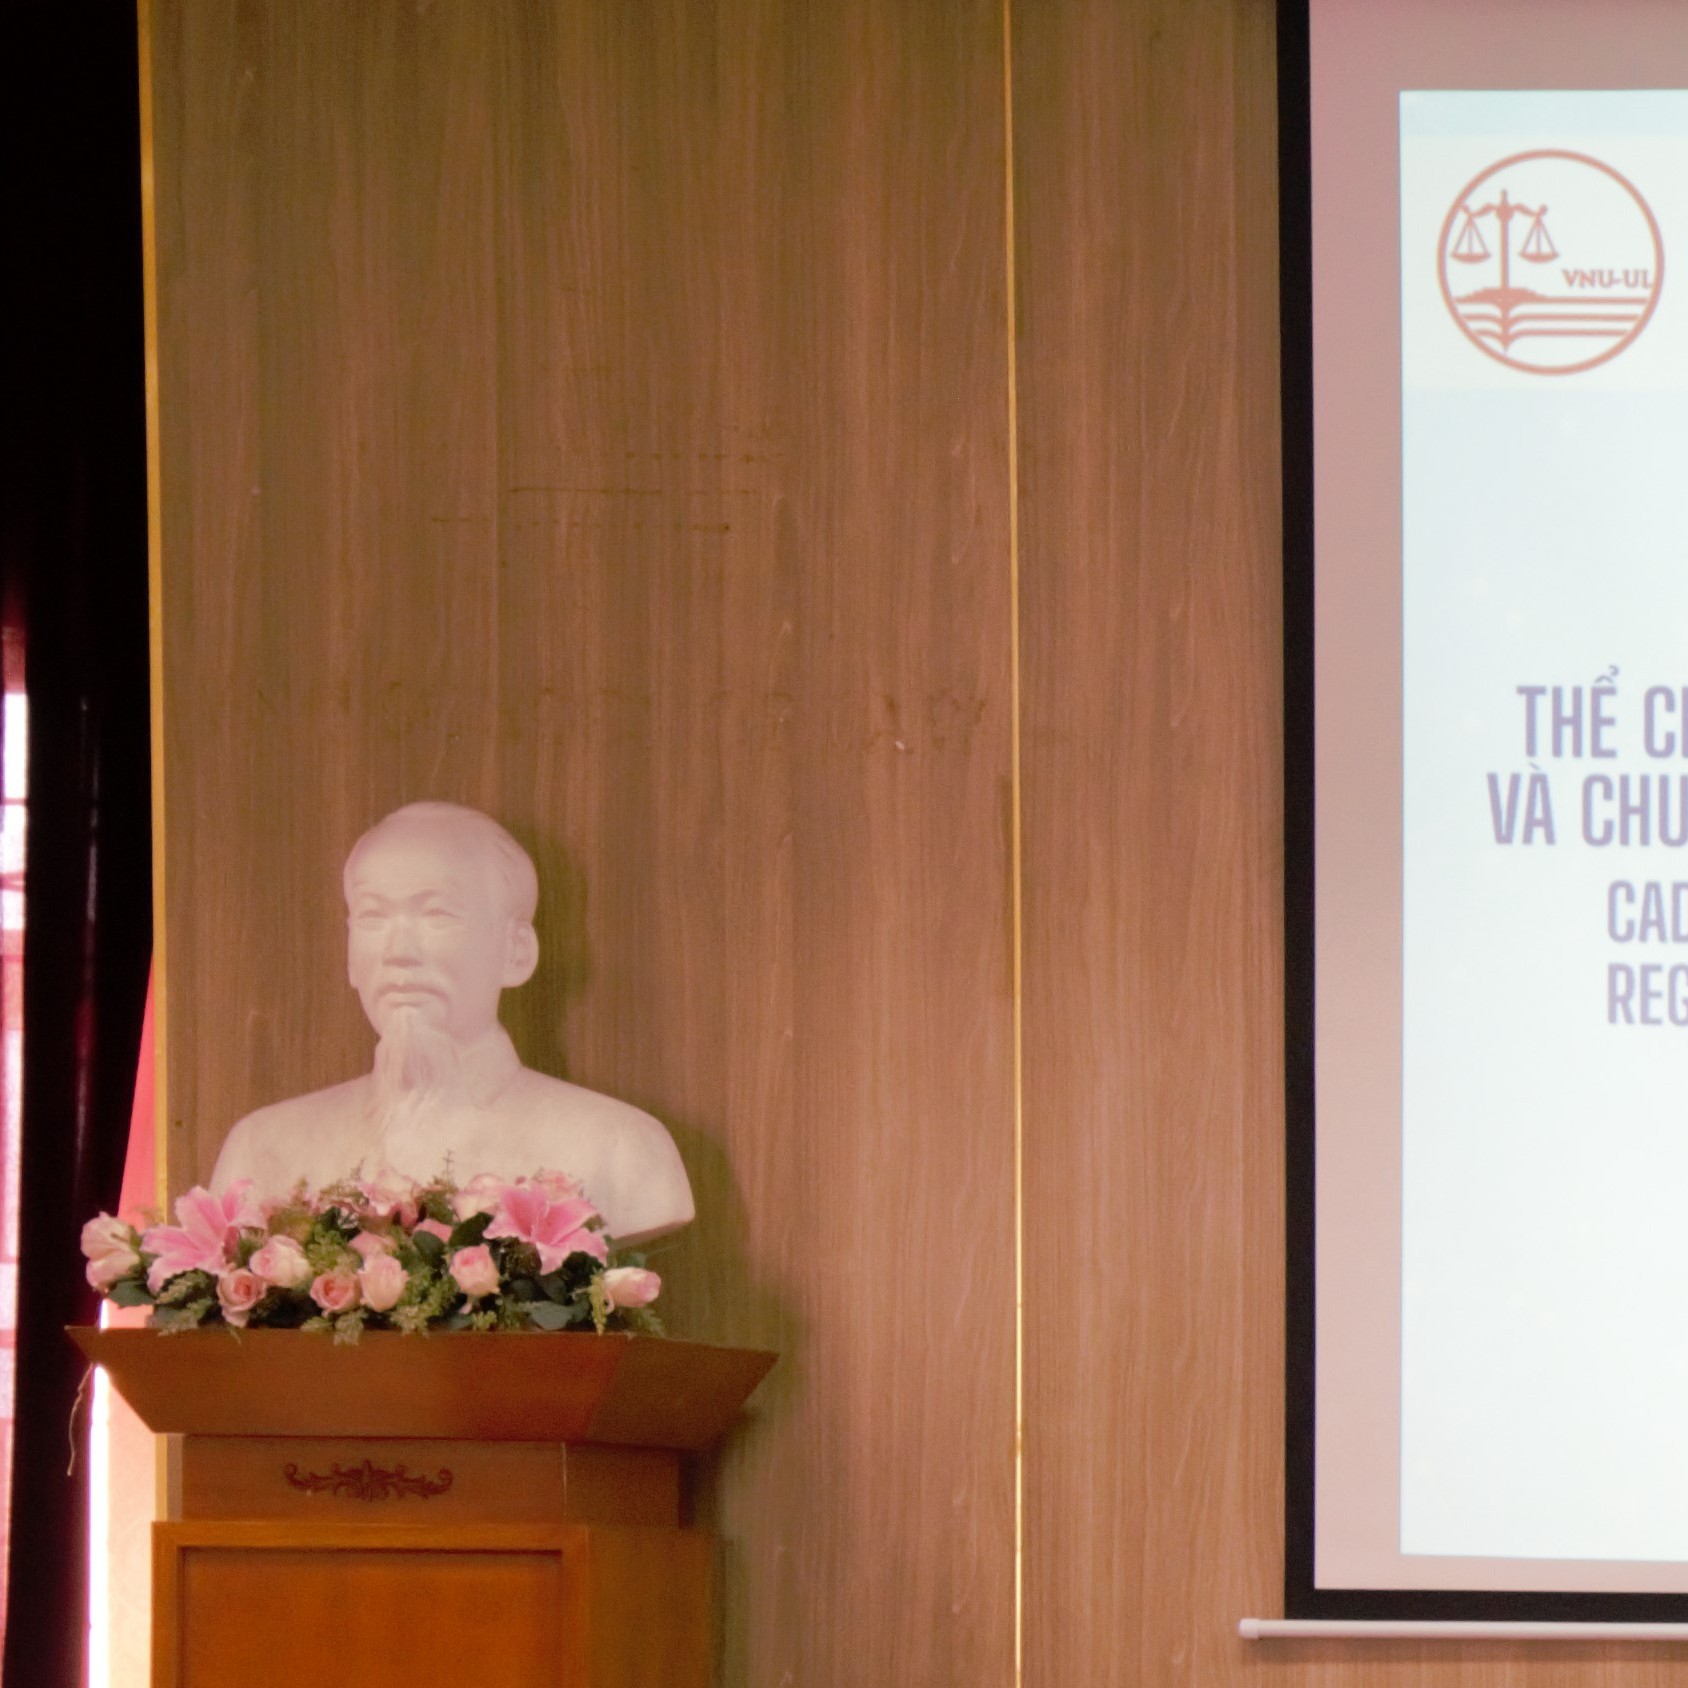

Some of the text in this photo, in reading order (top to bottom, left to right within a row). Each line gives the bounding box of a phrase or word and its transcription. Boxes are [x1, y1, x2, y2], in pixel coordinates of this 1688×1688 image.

[1562, 268, 1655, 289] VNU-UL
[1516, 665, 1619, 760] THỂ
[1486, 761, 1557, 847] VÀ
